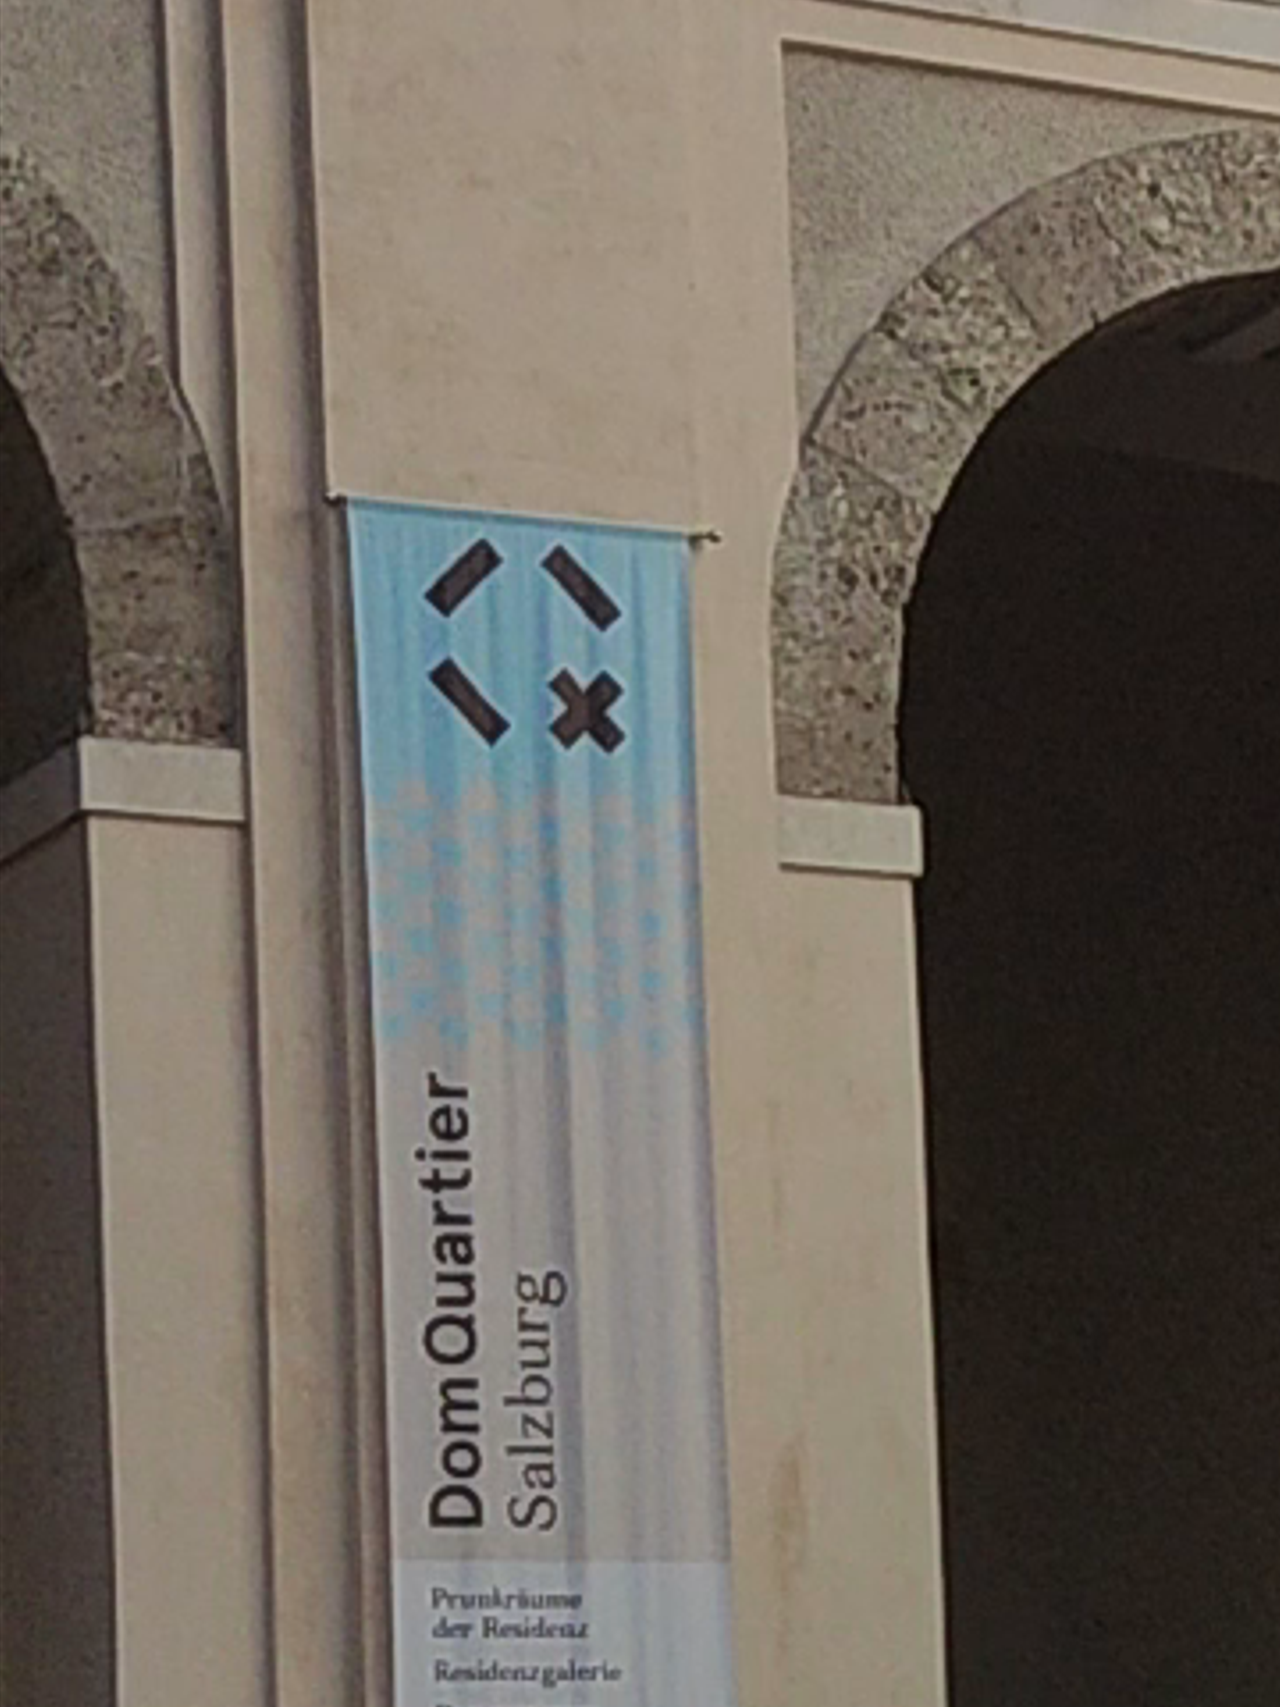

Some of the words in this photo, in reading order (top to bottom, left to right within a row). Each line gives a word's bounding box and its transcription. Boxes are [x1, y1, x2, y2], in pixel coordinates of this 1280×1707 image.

[415, 1072, 483, 1529] DomQuartier
[503, 1270, 567, 1531] Salzburg
[431, 1585, 583, 1610] Prunkräume
[432, 1617, 472, 1639] der
[482, 1615, 589, 1639] Residenz
[434, 1659, 622, 1687] Residenzgalerie
